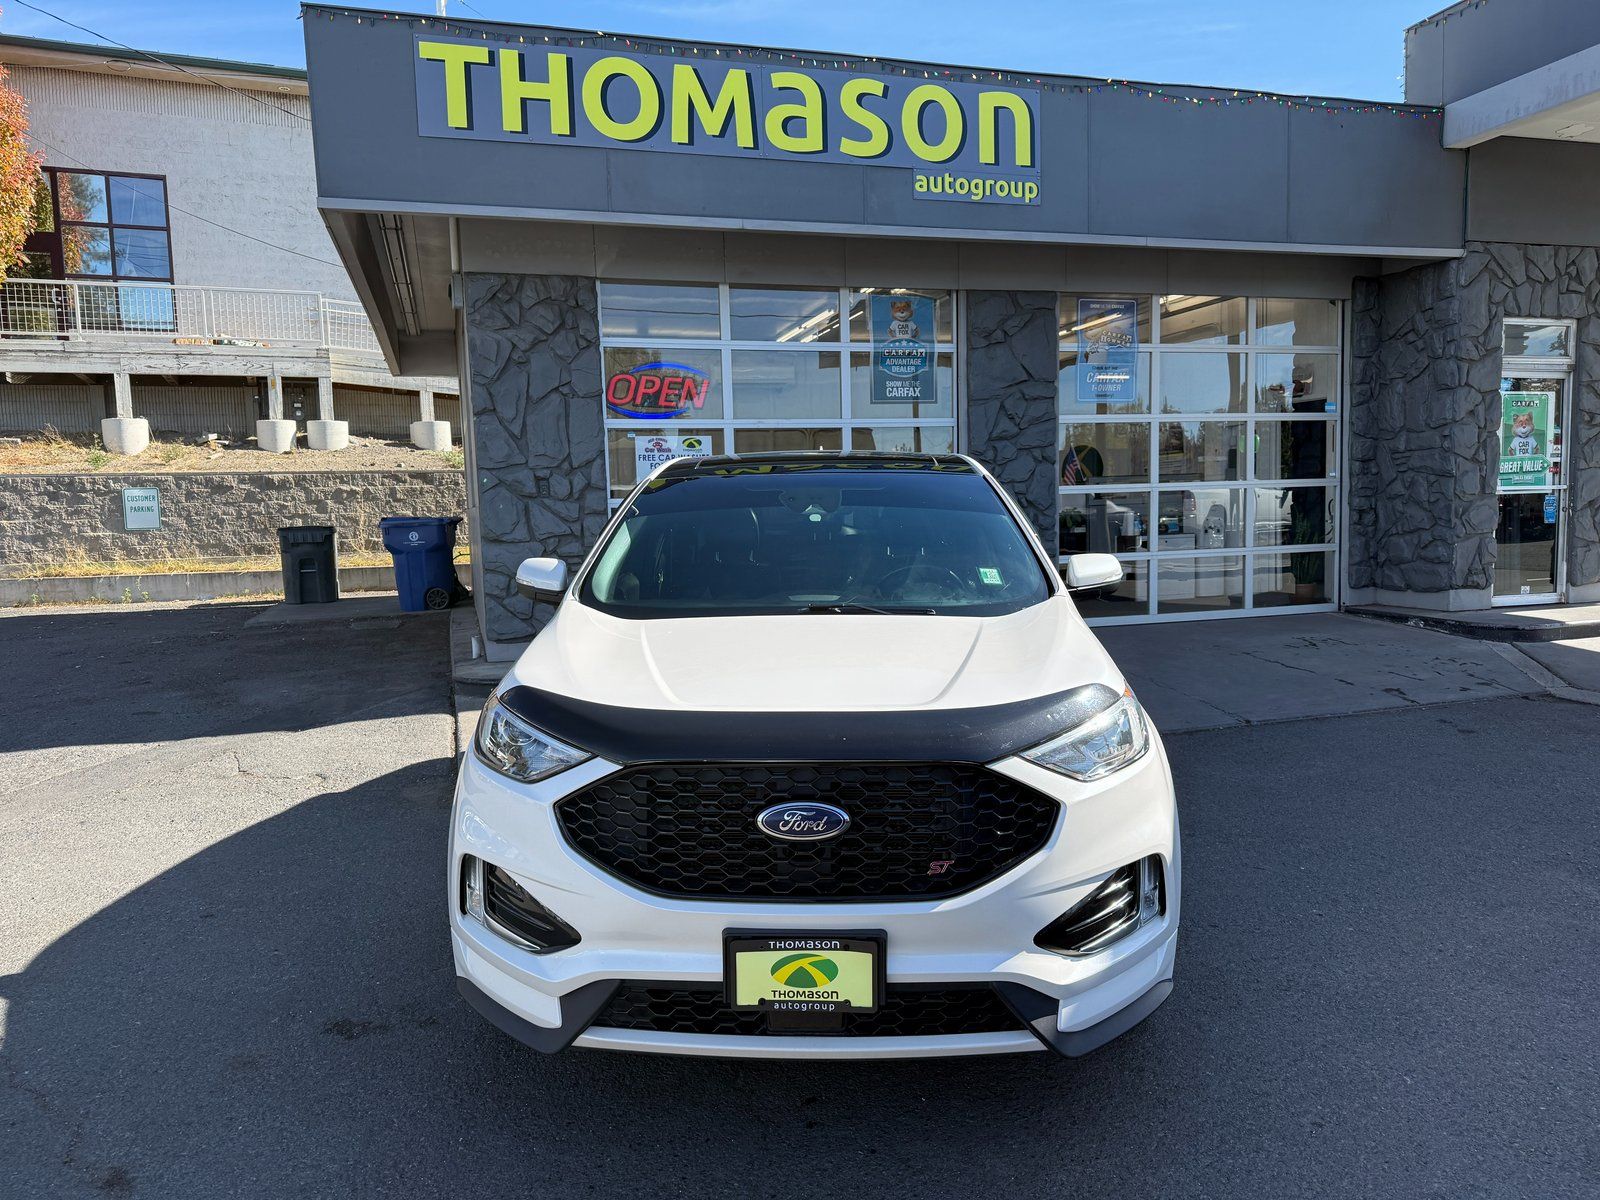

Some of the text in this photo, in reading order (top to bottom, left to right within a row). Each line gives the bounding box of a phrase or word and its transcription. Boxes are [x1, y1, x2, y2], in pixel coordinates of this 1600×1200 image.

[914, 172, 1039, 203] autogroup
[884, 349, 926, 357] CARFAX
[606, 374, 710, 408] OPEN
[886, 387, 921, 397] CARFAX
[1091, 384, 1121, 392] 1-OWNER
[638, 454, 656, 462] FREE
[1500, 461, 1521, 473] GREAT
[1522, 460, 1543, 472] VALUE
[779, 810, 828, 831] Ford
[927, 860, 955, 876] ST
[774, 1002, 835, 1011] autogroup
